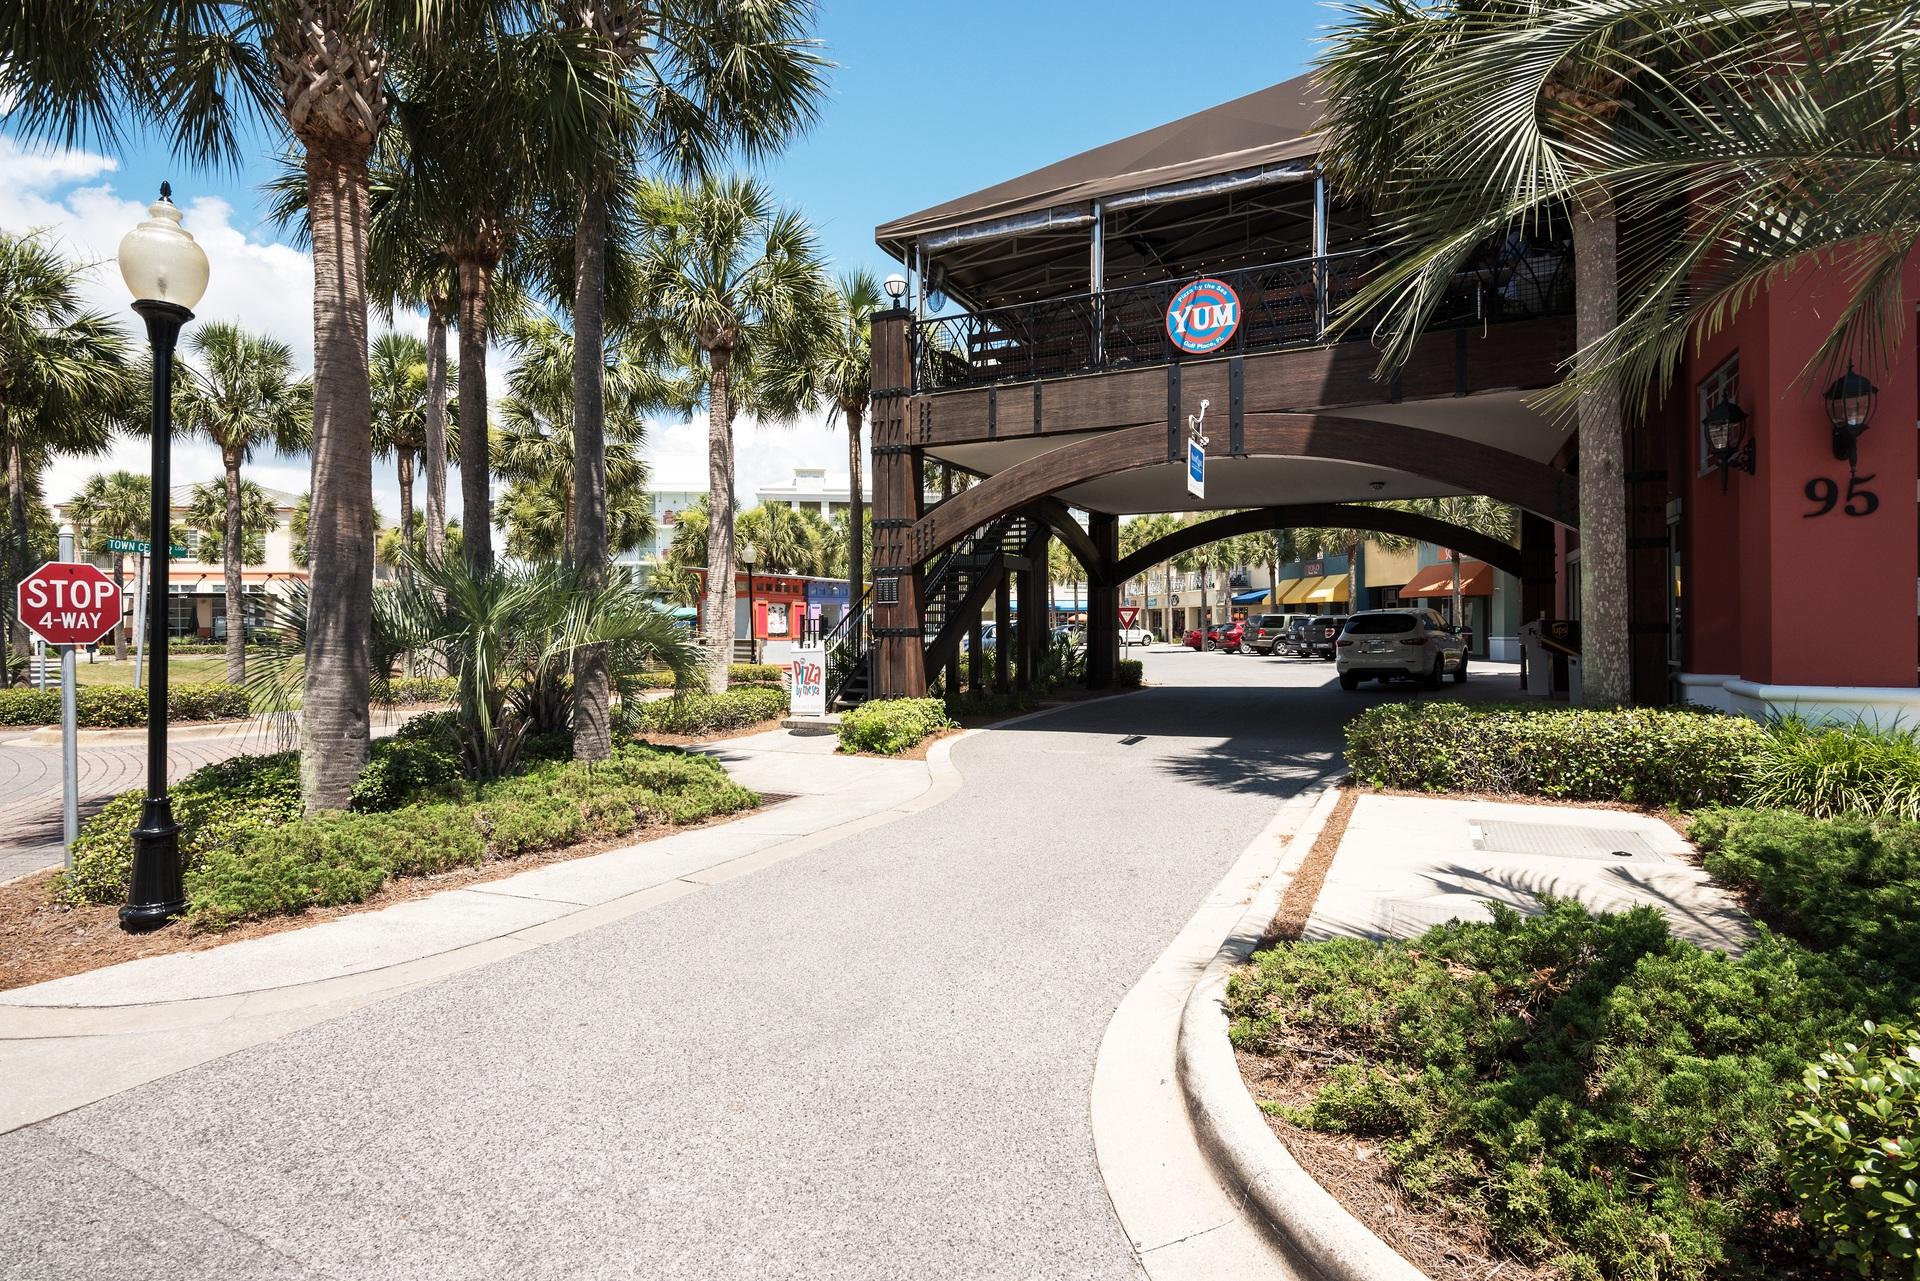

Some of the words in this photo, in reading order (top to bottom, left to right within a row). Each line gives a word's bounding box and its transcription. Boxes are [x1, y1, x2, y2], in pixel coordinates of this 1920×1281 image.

[1169, 302, 1237, 333] YUM
[1802, 473, 1880, 518] 95
[109, 539, 136, 551] TOWN
[26, 579, 115, 609] STOP
[38, 611, 103, 629] 4-WAY
[793, 658, 822, 686] Pizza
